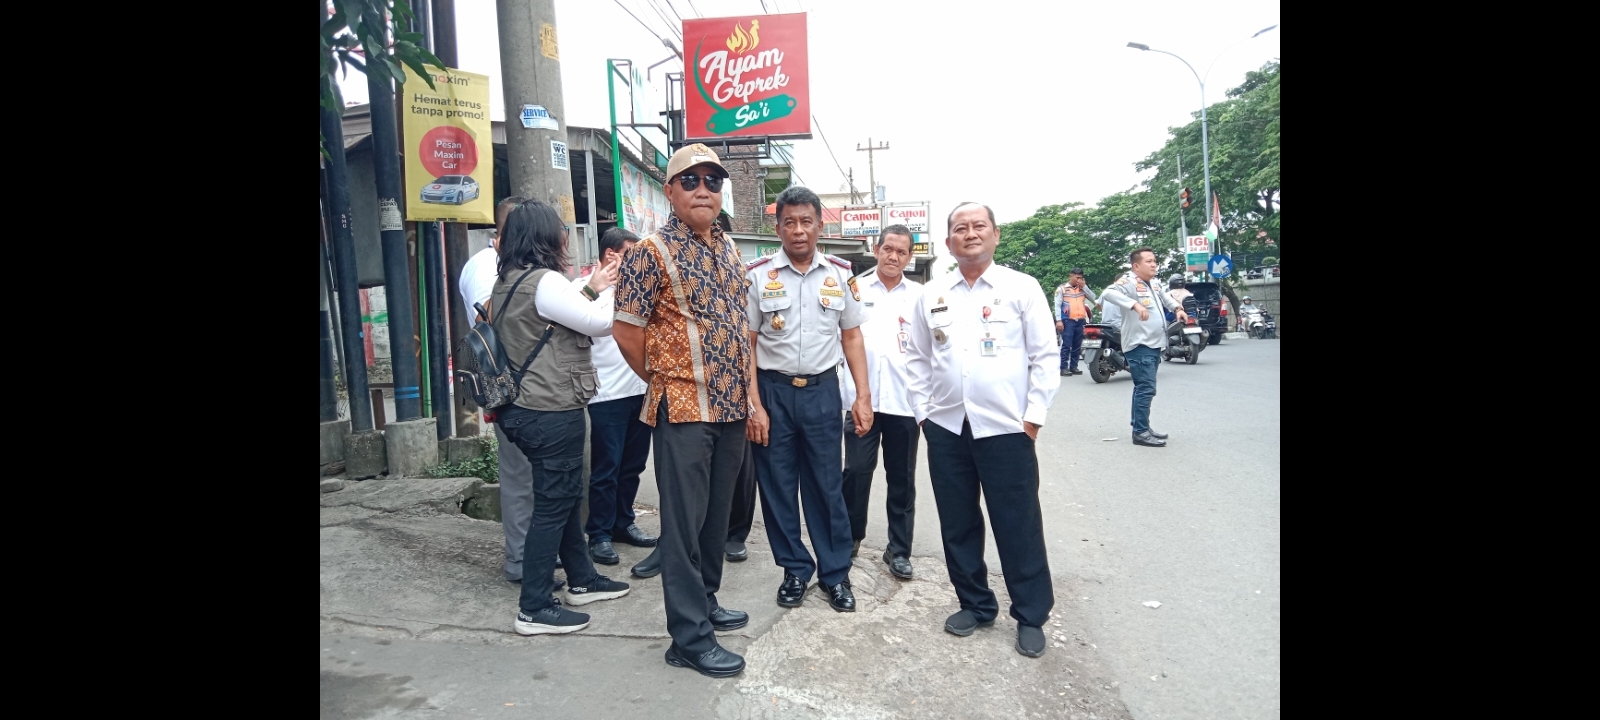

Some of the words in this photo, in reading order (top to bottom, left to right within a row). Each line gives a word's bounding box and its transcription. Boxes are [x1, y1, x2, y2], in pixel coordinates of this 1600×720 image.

[700, 48, 784, 86] Ayam
[713, 66, 789, 103] Geprek
[414, 93, 451, 106] Hemat
[454, 98, 481, 109] terus
[411, 105, 443, 117] tanpa
[446, 110, 484, 120] promo!
[523, 108, 547, 118] SERVICE
[735, 102, 770, 127] Sa'i
[436, 140, 461, 149] Pesan
[434, 150, 464, 159] Maxim
[442, 161, 457, 169] Car
[843, 212, 879, 222] Canon
[889, 209, 926, 218] Canon
